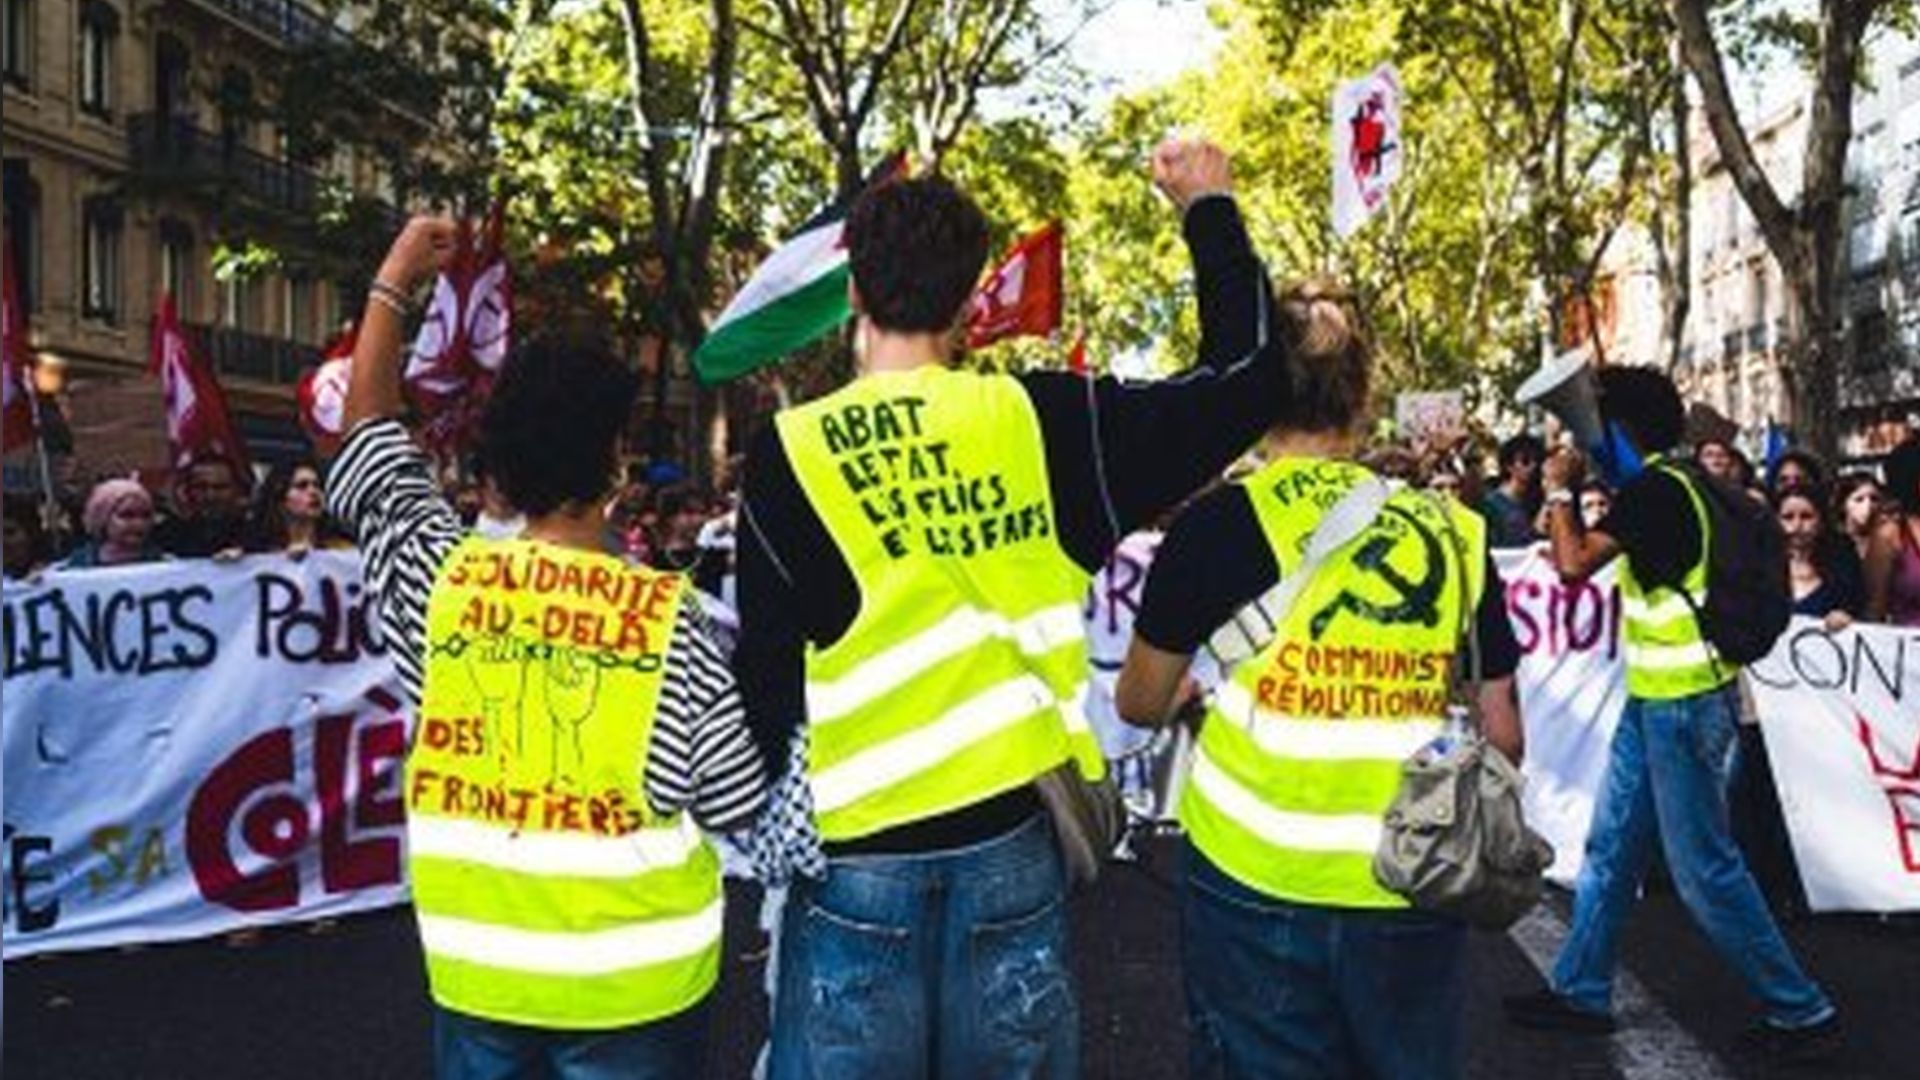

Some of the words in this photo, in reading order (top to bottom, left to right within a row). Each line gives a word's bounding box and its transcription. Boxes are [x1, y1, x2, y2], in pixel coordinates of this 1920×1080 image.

[821, 397, 924, 454] ABAT
[915, 475, 1006, 519] FLICS
[423, 716, 485, 756] DES
